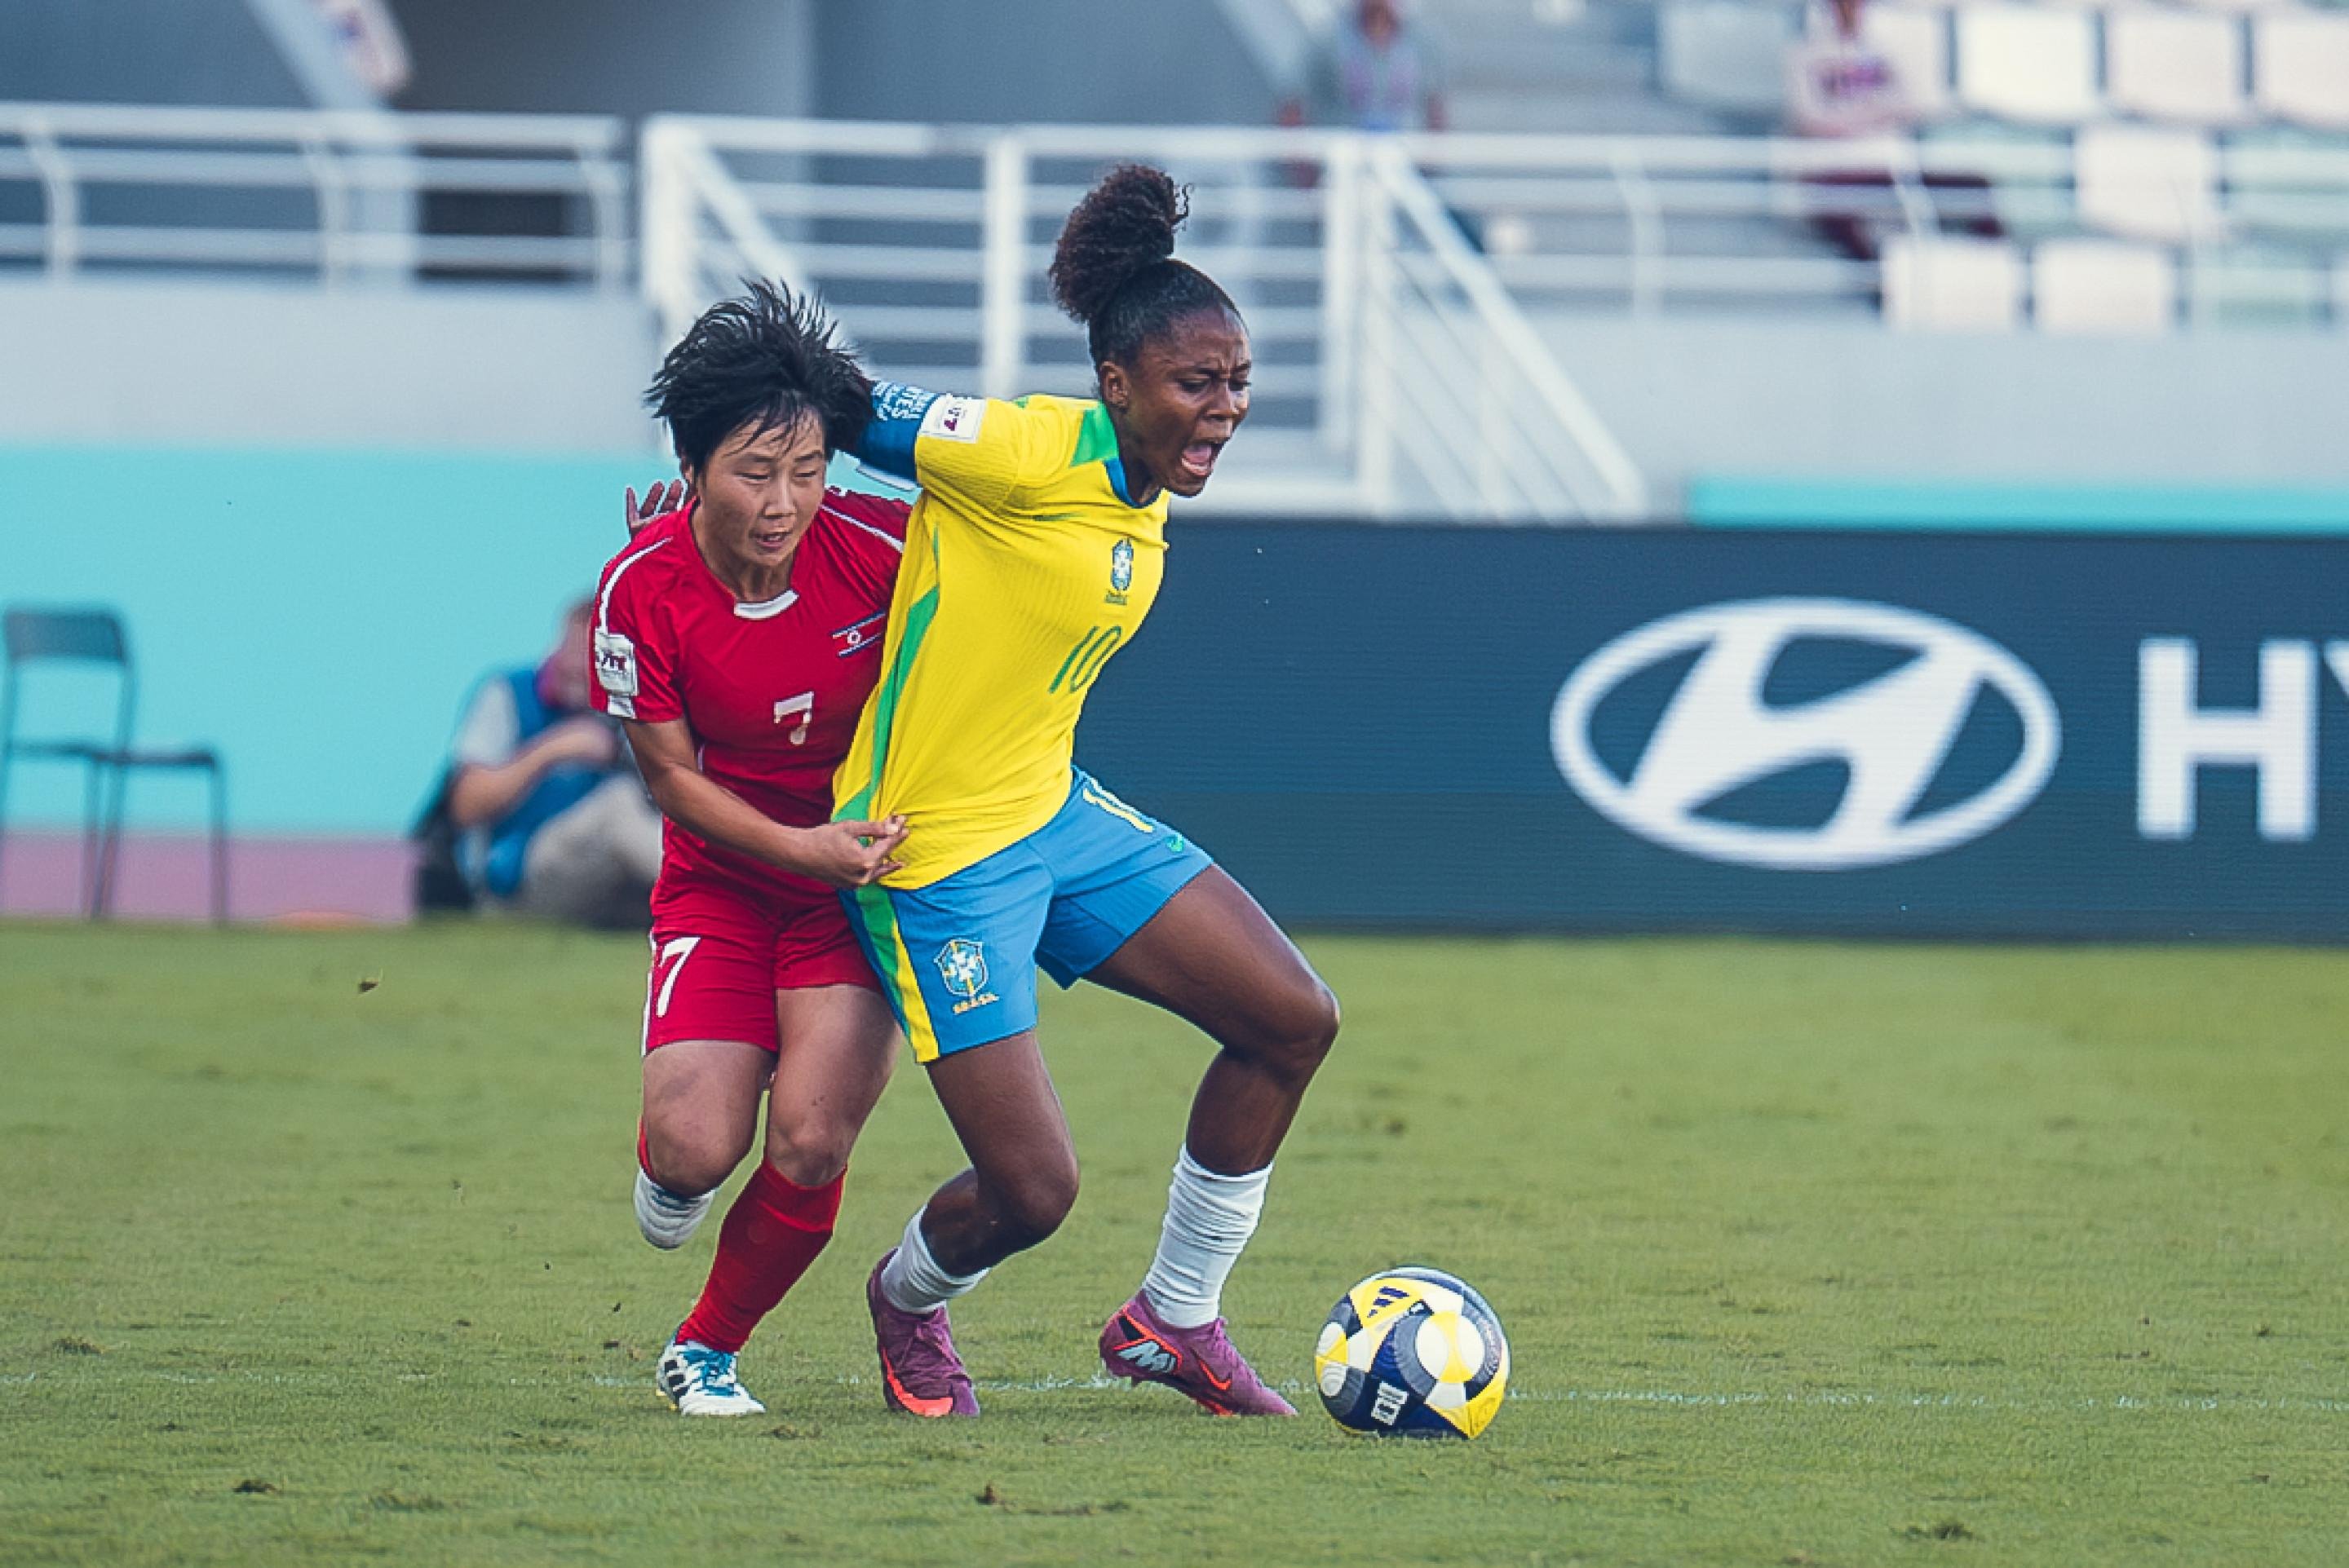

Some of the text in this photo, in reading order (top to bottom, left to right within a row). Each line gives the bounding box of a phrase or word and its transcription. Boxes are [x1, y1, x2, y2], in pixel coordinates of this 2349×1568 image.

[1048, 625, 1121, 693] 10
[773, 691, 814, 745] 7
[2138, 634, 2349, 840] H
[656, 937, 701, 1018] 7
